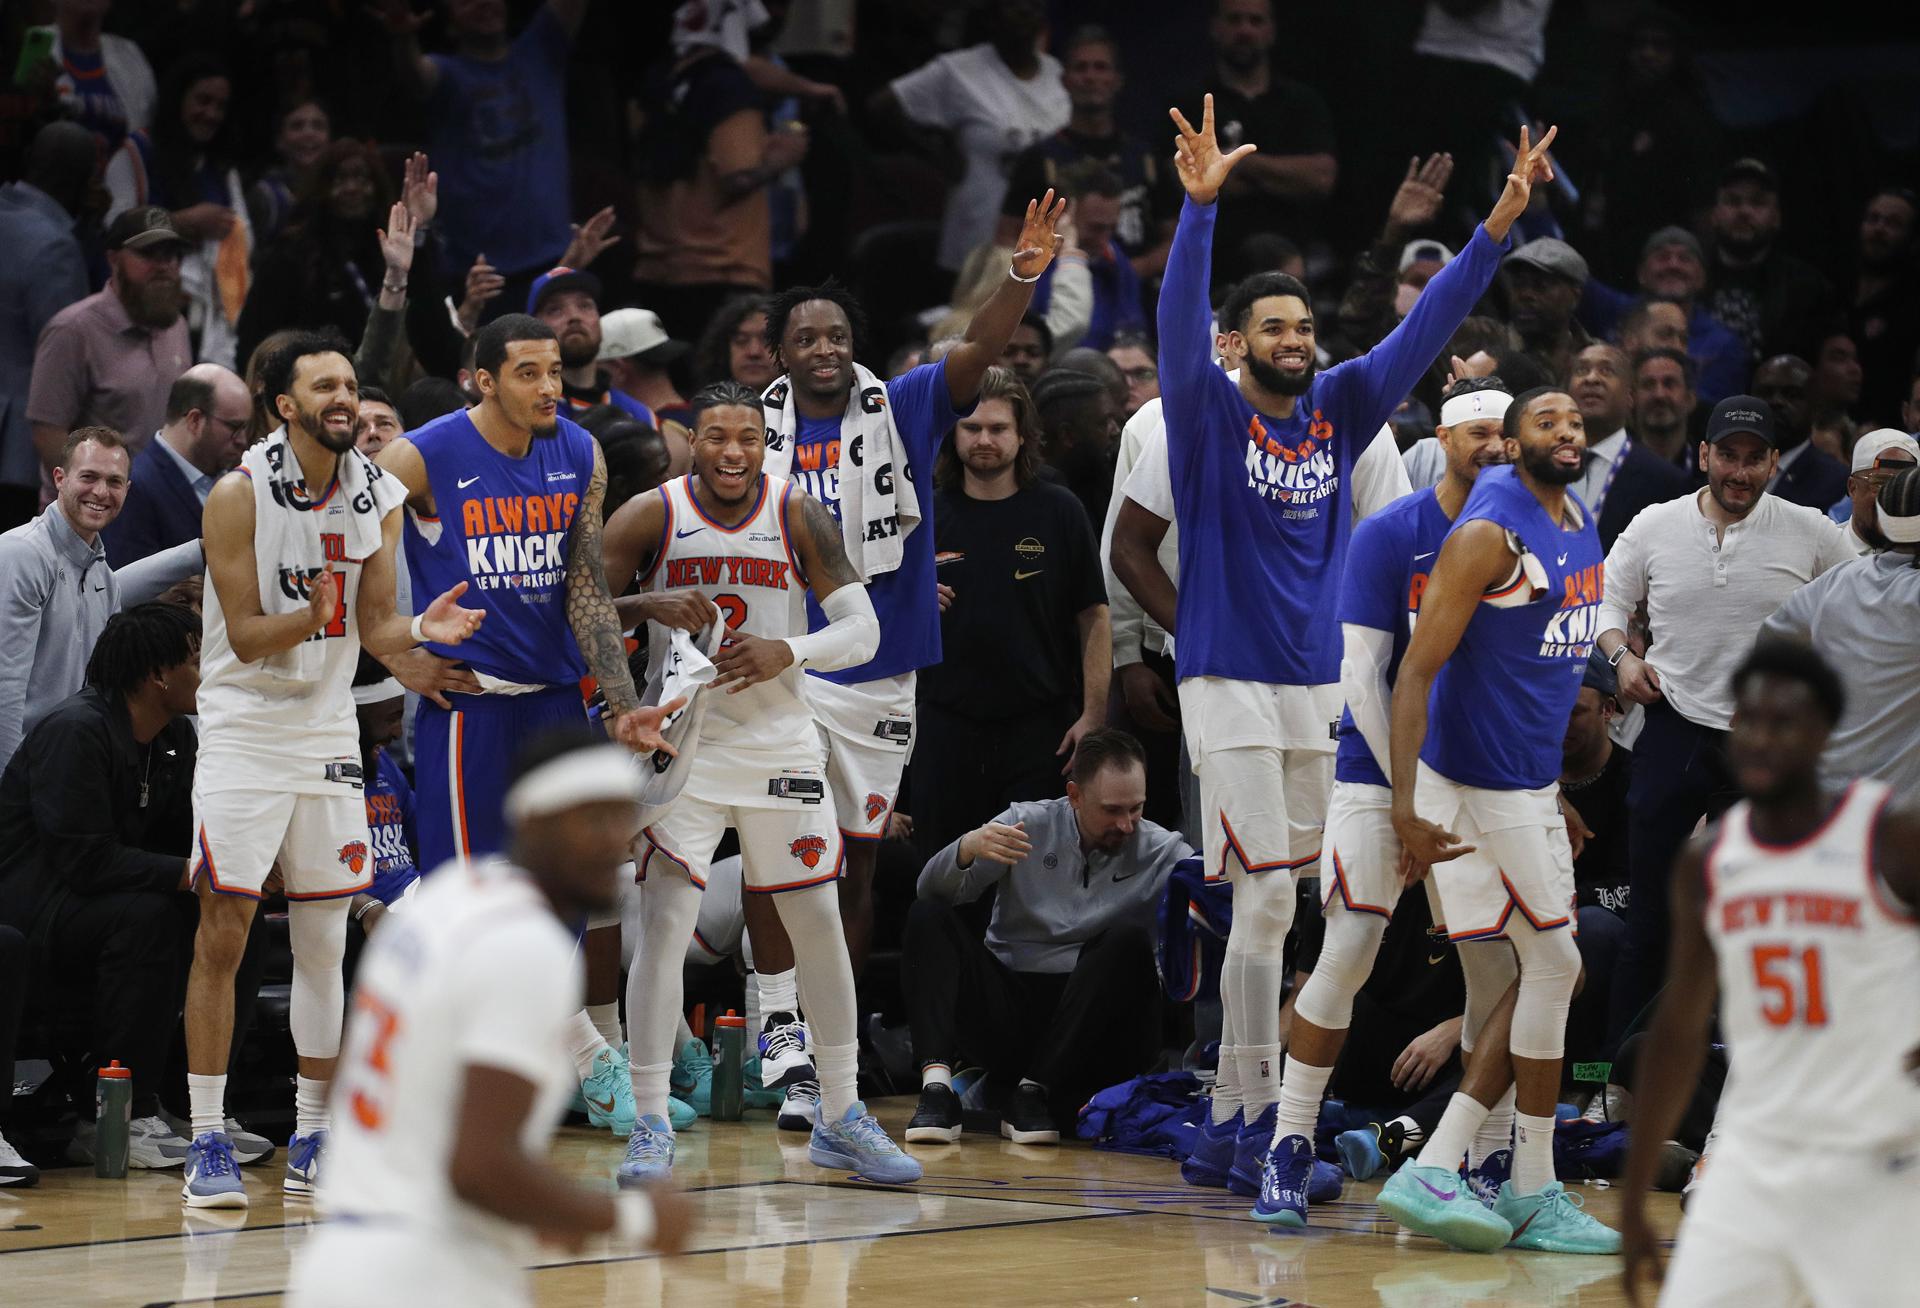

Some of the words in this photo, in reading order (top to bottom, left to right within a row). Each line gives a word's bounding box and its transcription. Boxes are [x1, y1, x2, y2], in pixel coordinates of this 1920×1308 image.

[462, 492, 579, 537] ALWAYS
[466, 531, 568, 575] KNICK
[666, 556, 724, 589] NEW
[725, 556, 789, 591] YORK
[1753, 945, 1828, 1030] 51
